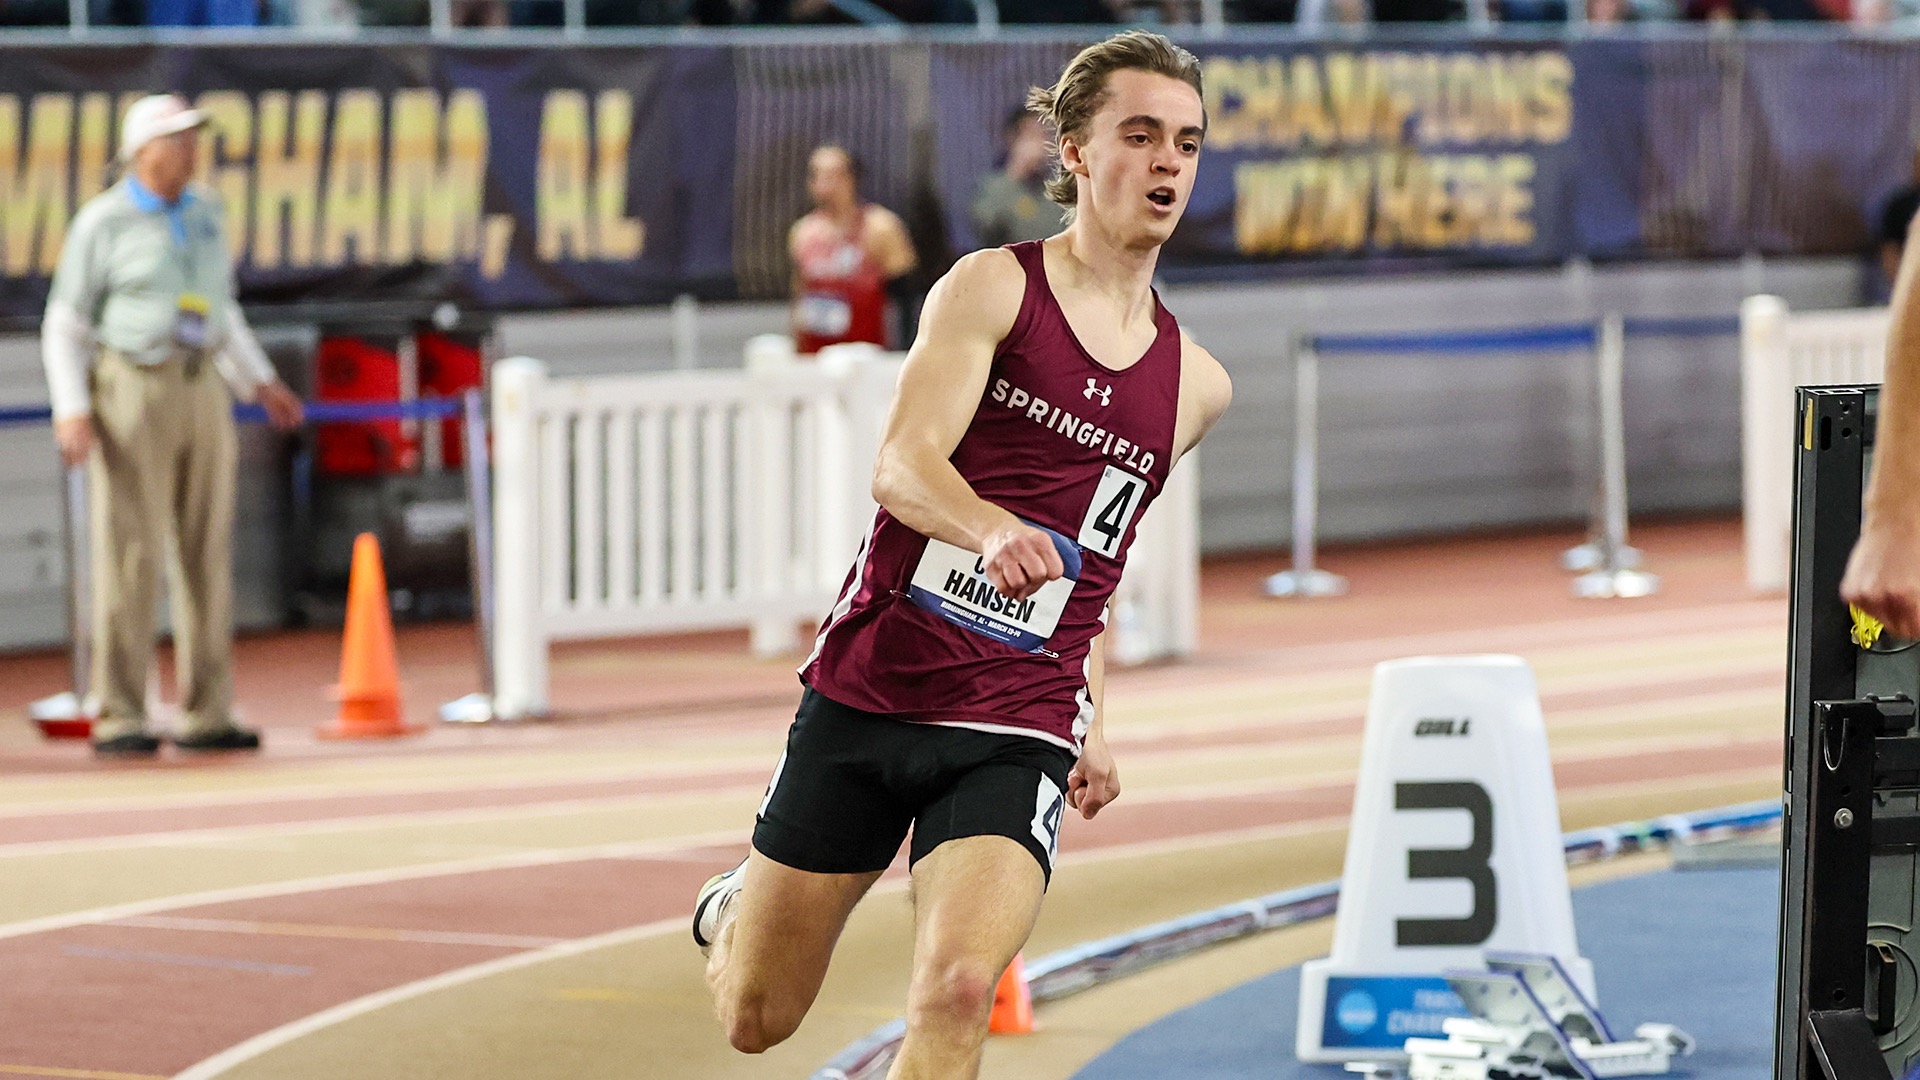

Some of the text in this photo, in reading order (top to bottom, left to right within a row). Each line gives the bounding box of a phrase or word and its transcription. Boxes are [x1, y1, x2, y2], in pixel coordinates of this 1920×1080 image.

[535, 88, 645, 262] AL
[991, 378, 1156, 475] SPRINGFIELD
[1092, 480, 1137, 552] 4
[943, 568, 1037, 624] HANSEN
[987, 620, 1008, 633] MARCH
[1042, 793, 1063, 858] 4
[1394, 780, 1498, 947] 3
